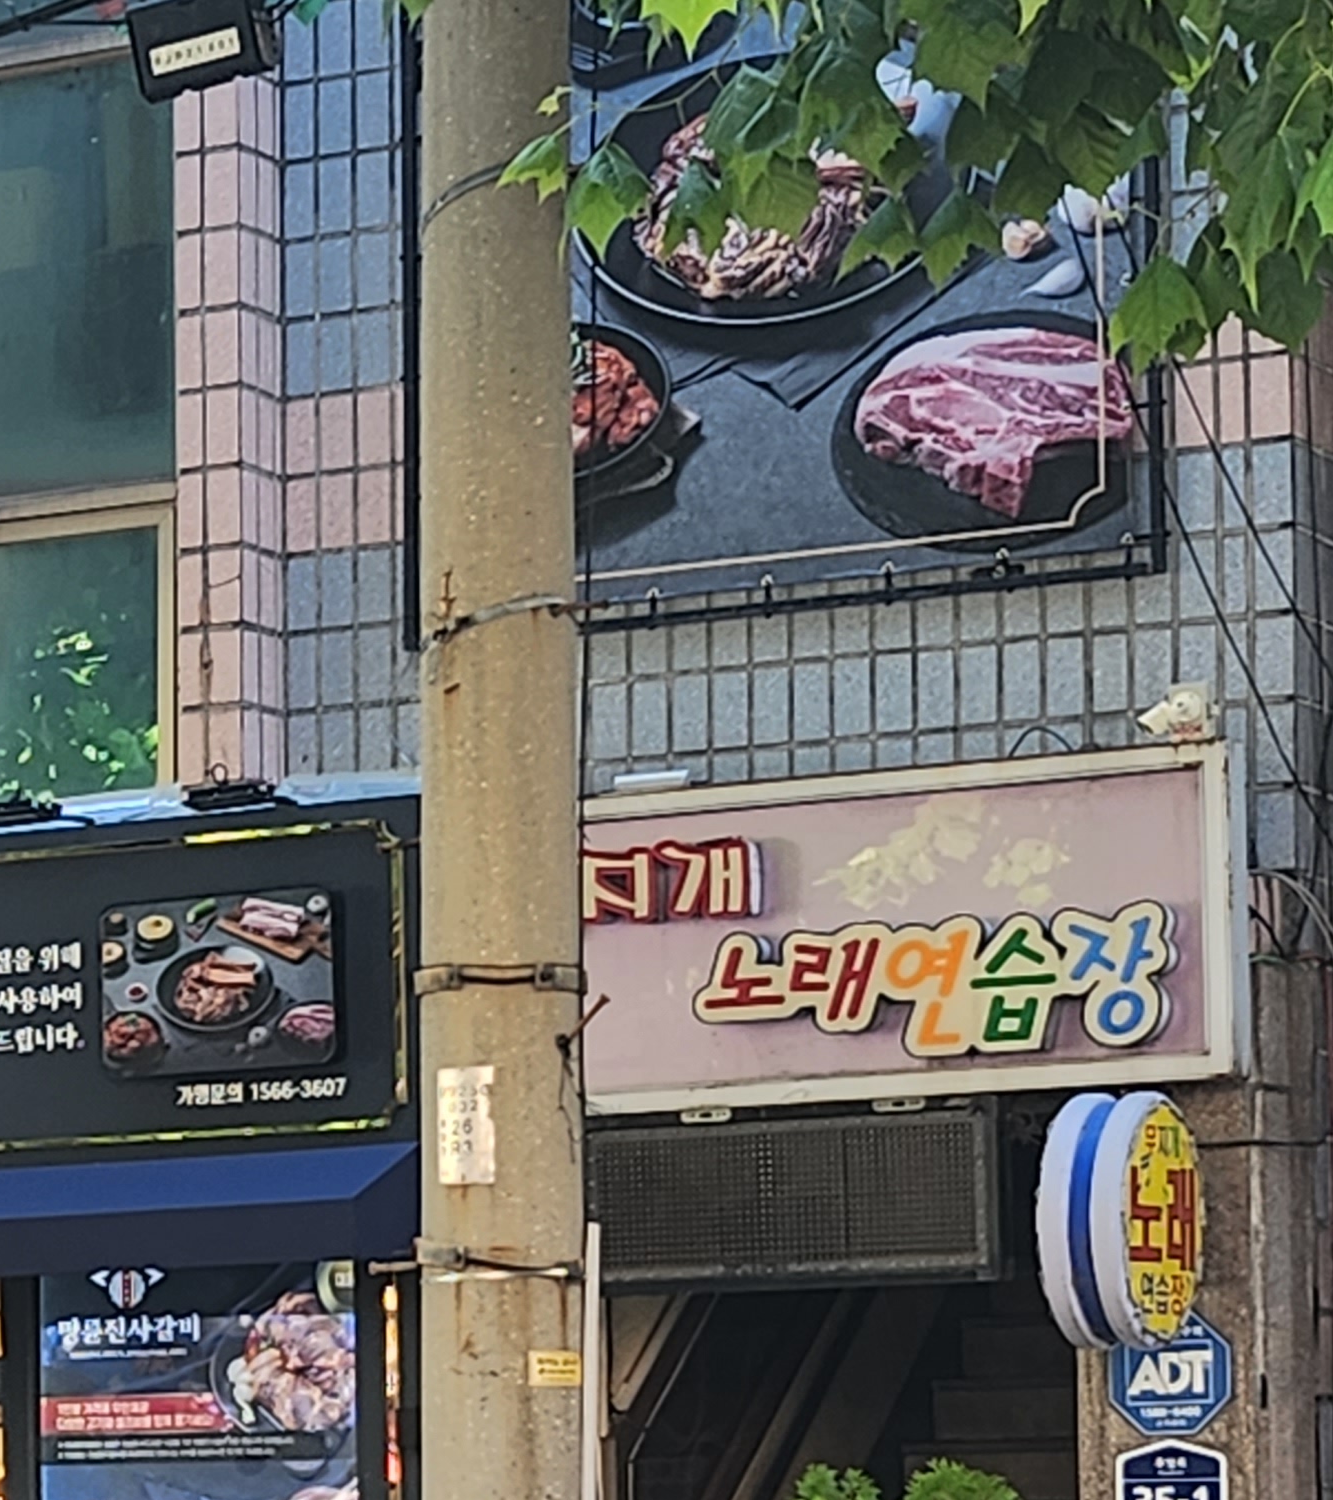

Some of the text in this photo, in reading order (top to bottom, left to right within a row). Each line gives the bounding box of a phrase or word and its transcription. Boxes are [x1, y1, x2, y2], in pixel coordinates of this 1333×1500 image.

[38, 942, 82, 972] 위해
[699, 912, 1161, 1050] 노래연습장
[176, 1082, 244, 1106] 가맹문의
[1128, 1165, 1195, 1271] 노래
[57, 1313, 201, 1345] 명륜진사갈비
[1127, 1351, 1214, 1396] ADT
